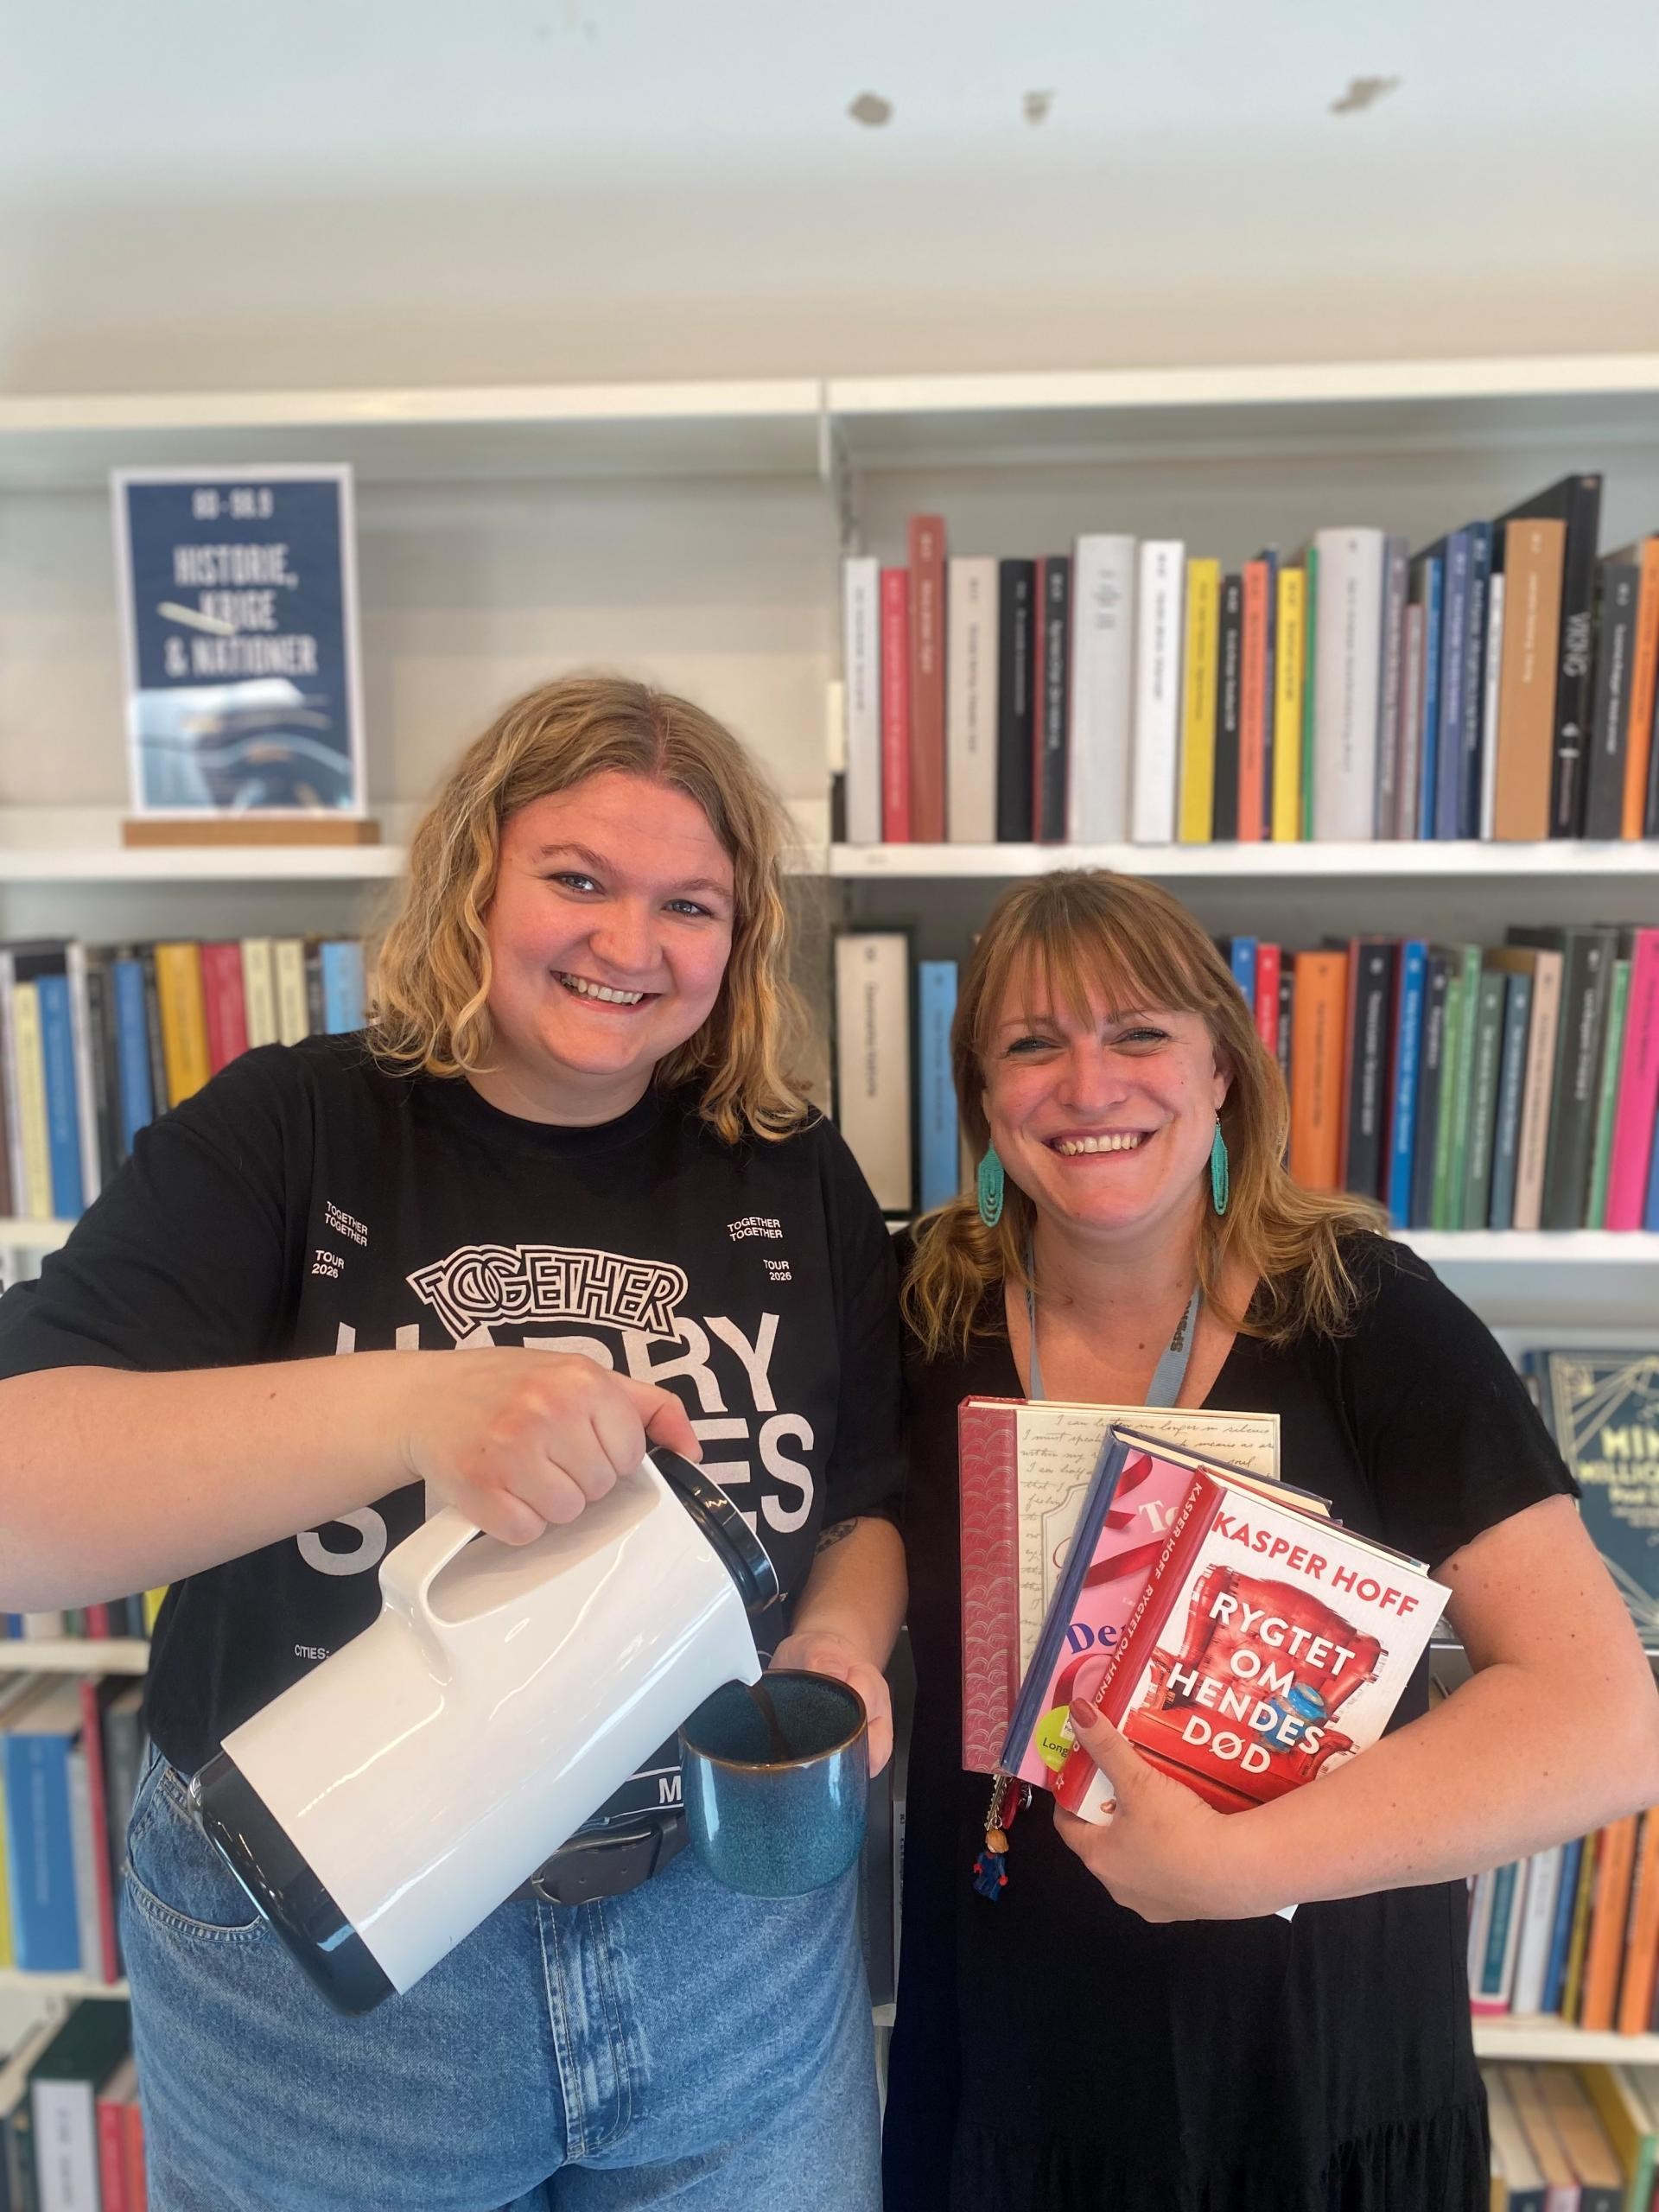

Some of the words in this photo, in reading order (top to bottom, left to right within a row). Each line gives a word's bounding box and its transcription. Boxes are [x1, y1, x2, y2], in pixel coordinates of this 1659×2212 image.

[174, 543, 300, 591] HISTORIE,
[164, 635, 188, 678] &
[190, 633, 318, 678] NATIONER
[324, 1212, 368, 1247] TOGETHER
[327, 1200, 368, 1236] TOGETHER
[727, 1216, 781, 1233] TOGETHER
[729, 1227, 784, 1242] TOGETHER
[311, 1262, 339, 1279] 2026
[315, 1249, 345, 1269] TOUR
[763, 1259, 790, 1270] TOUR
[769, 1271, 792, 1281] 2026
[405, 1244, 689, 1344] TOGETHER
[1173, 1481, 1203, 1539] KASPER
[1154, 1537, 1176, 1580] HOFF
[1212, 1511, 1328, 1580] KASPER
[1331, 1565, 1420, 1618] HOFF
[1127, 1583, 1154, 1639] RYGTET
[1112, 1637, 1130, 1669] OM
[1209, 1591, 1356, 1677] RYGTET
[1092, 1667, 1118, 1710] HEND
[1230, 1649, 1298, 1698] OM
[1167, 1662, 1326, 1755] HENDES
[1180, 1714, 1272, 1774] DØD
